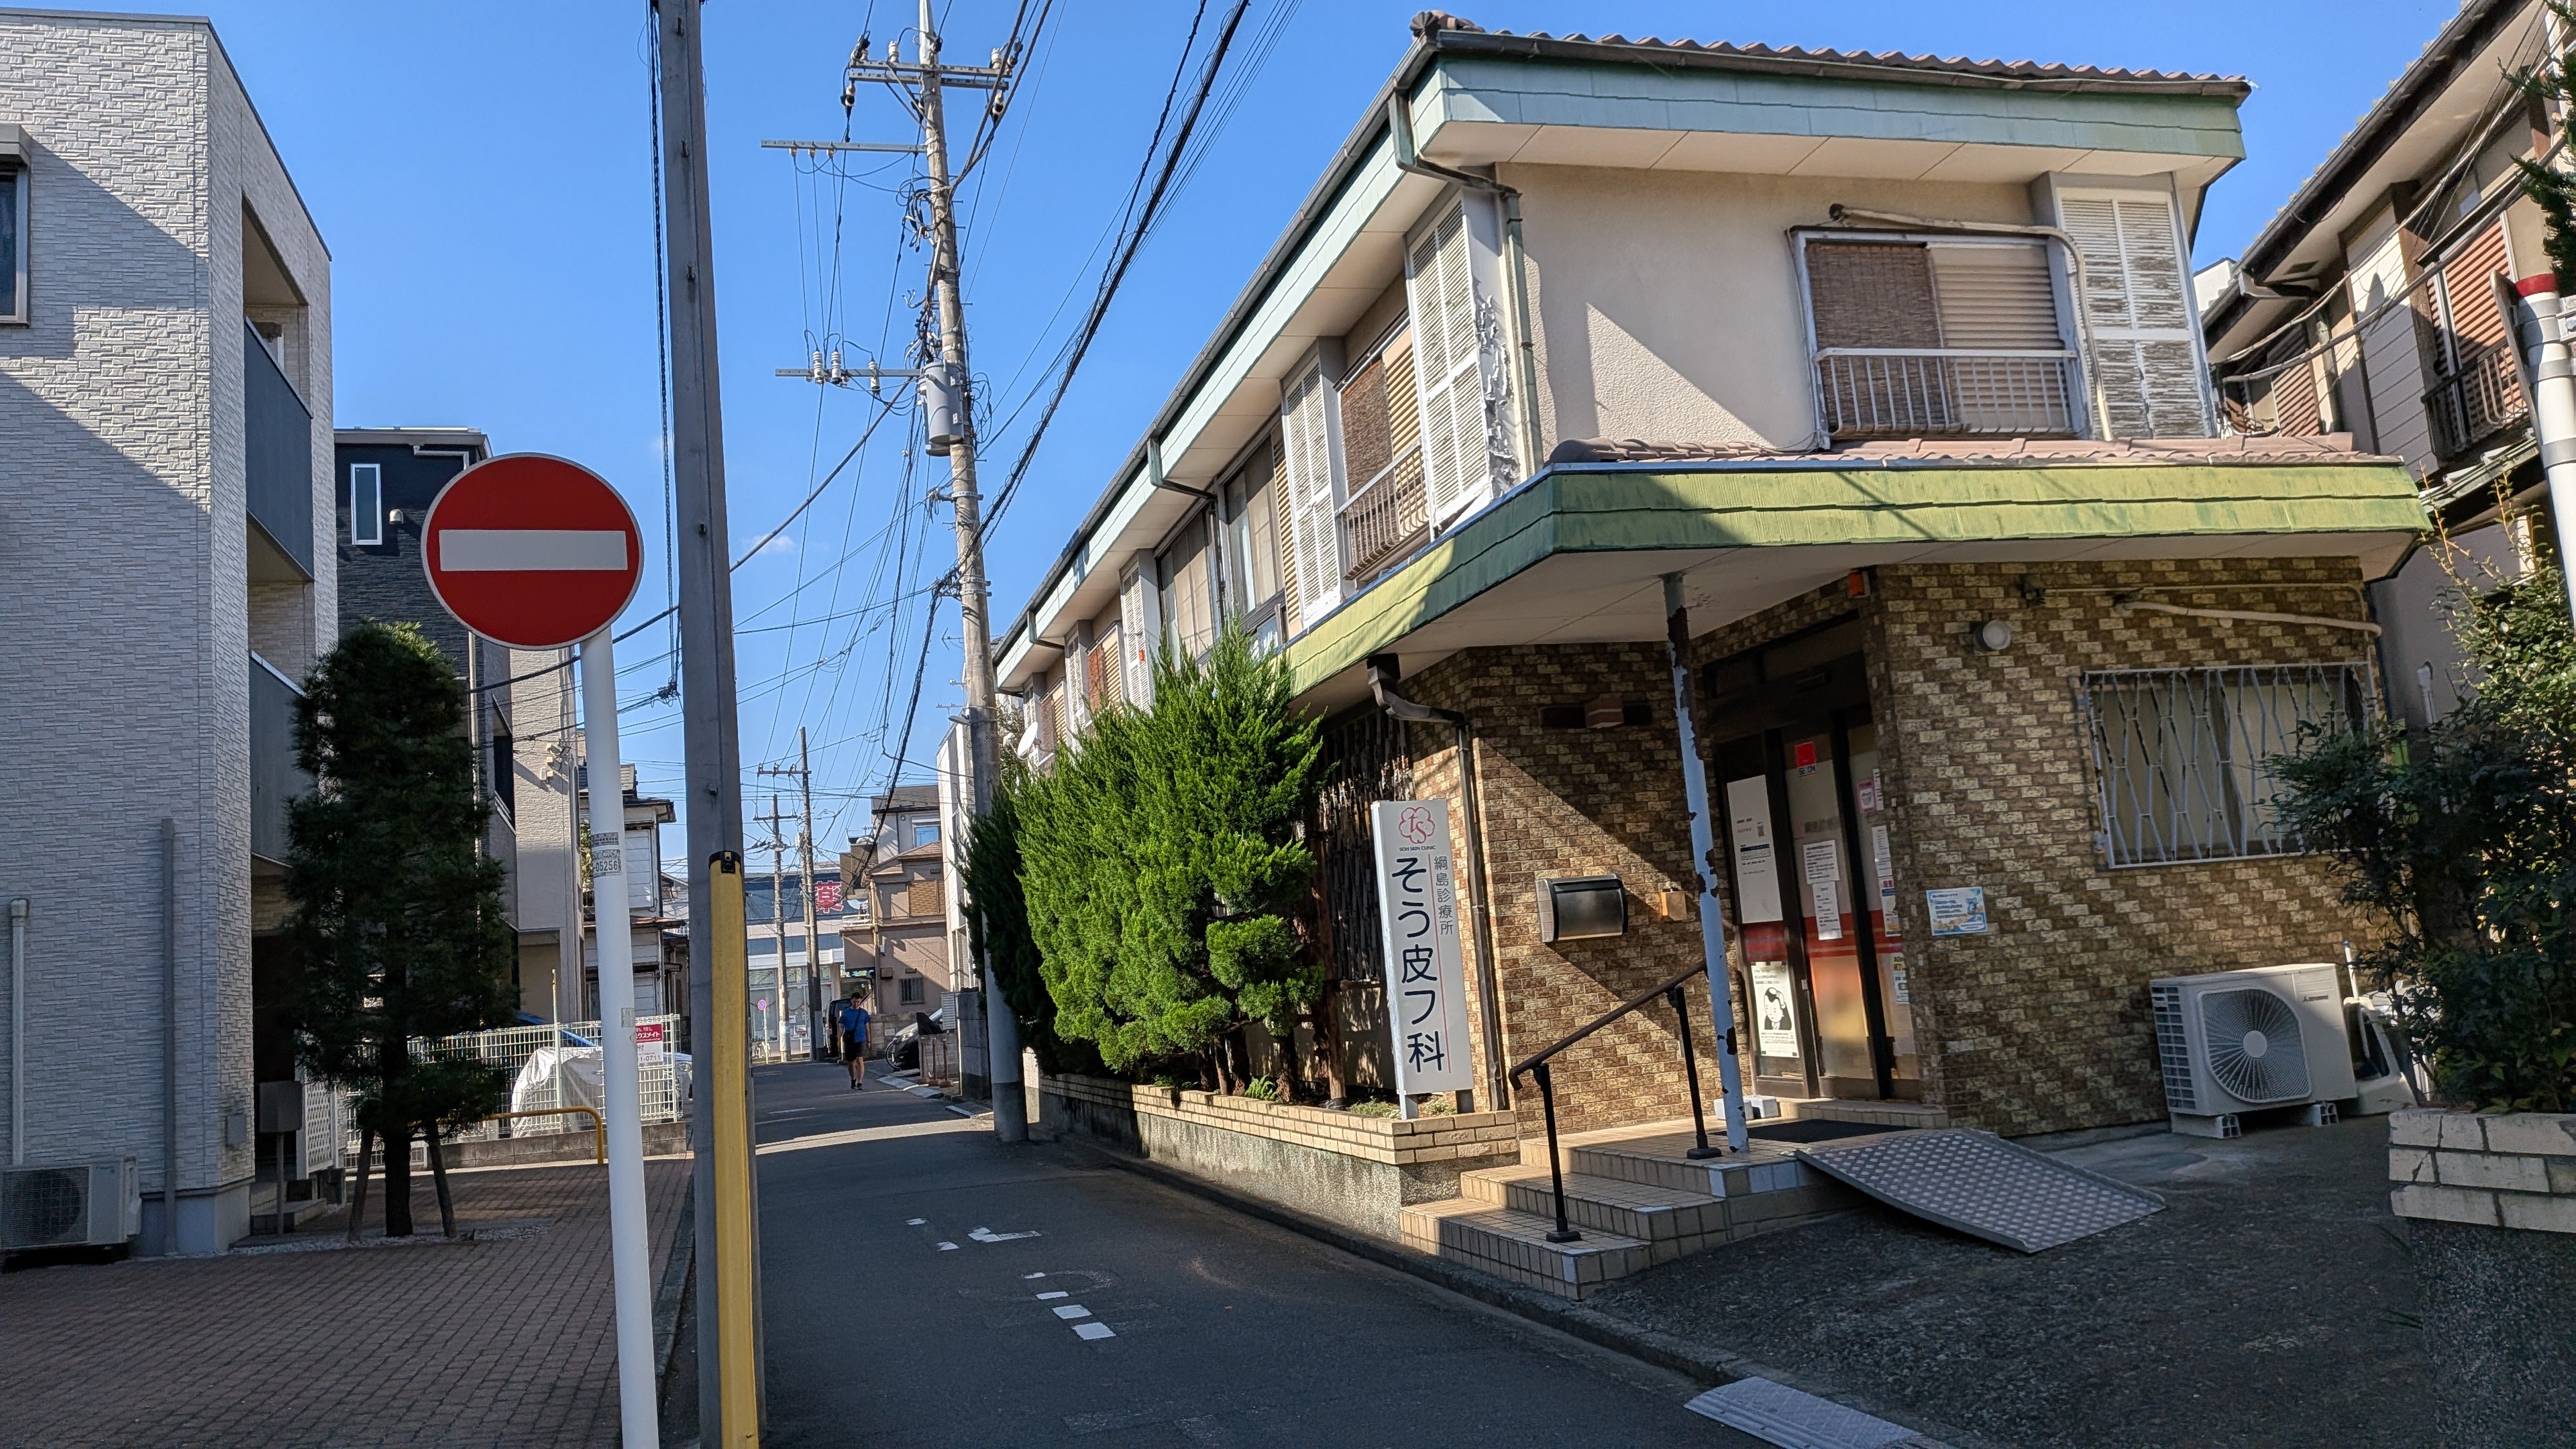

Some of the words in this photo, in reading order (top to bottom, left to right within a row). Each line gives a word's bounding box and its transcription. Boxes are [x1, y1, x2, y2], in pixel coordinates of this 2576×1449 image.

[814, 880, 845, 914] 薬
[1434, 855, 1454, 935] 綱島診療所
[1391, 857, 1446, 1073] そう皮フ科
